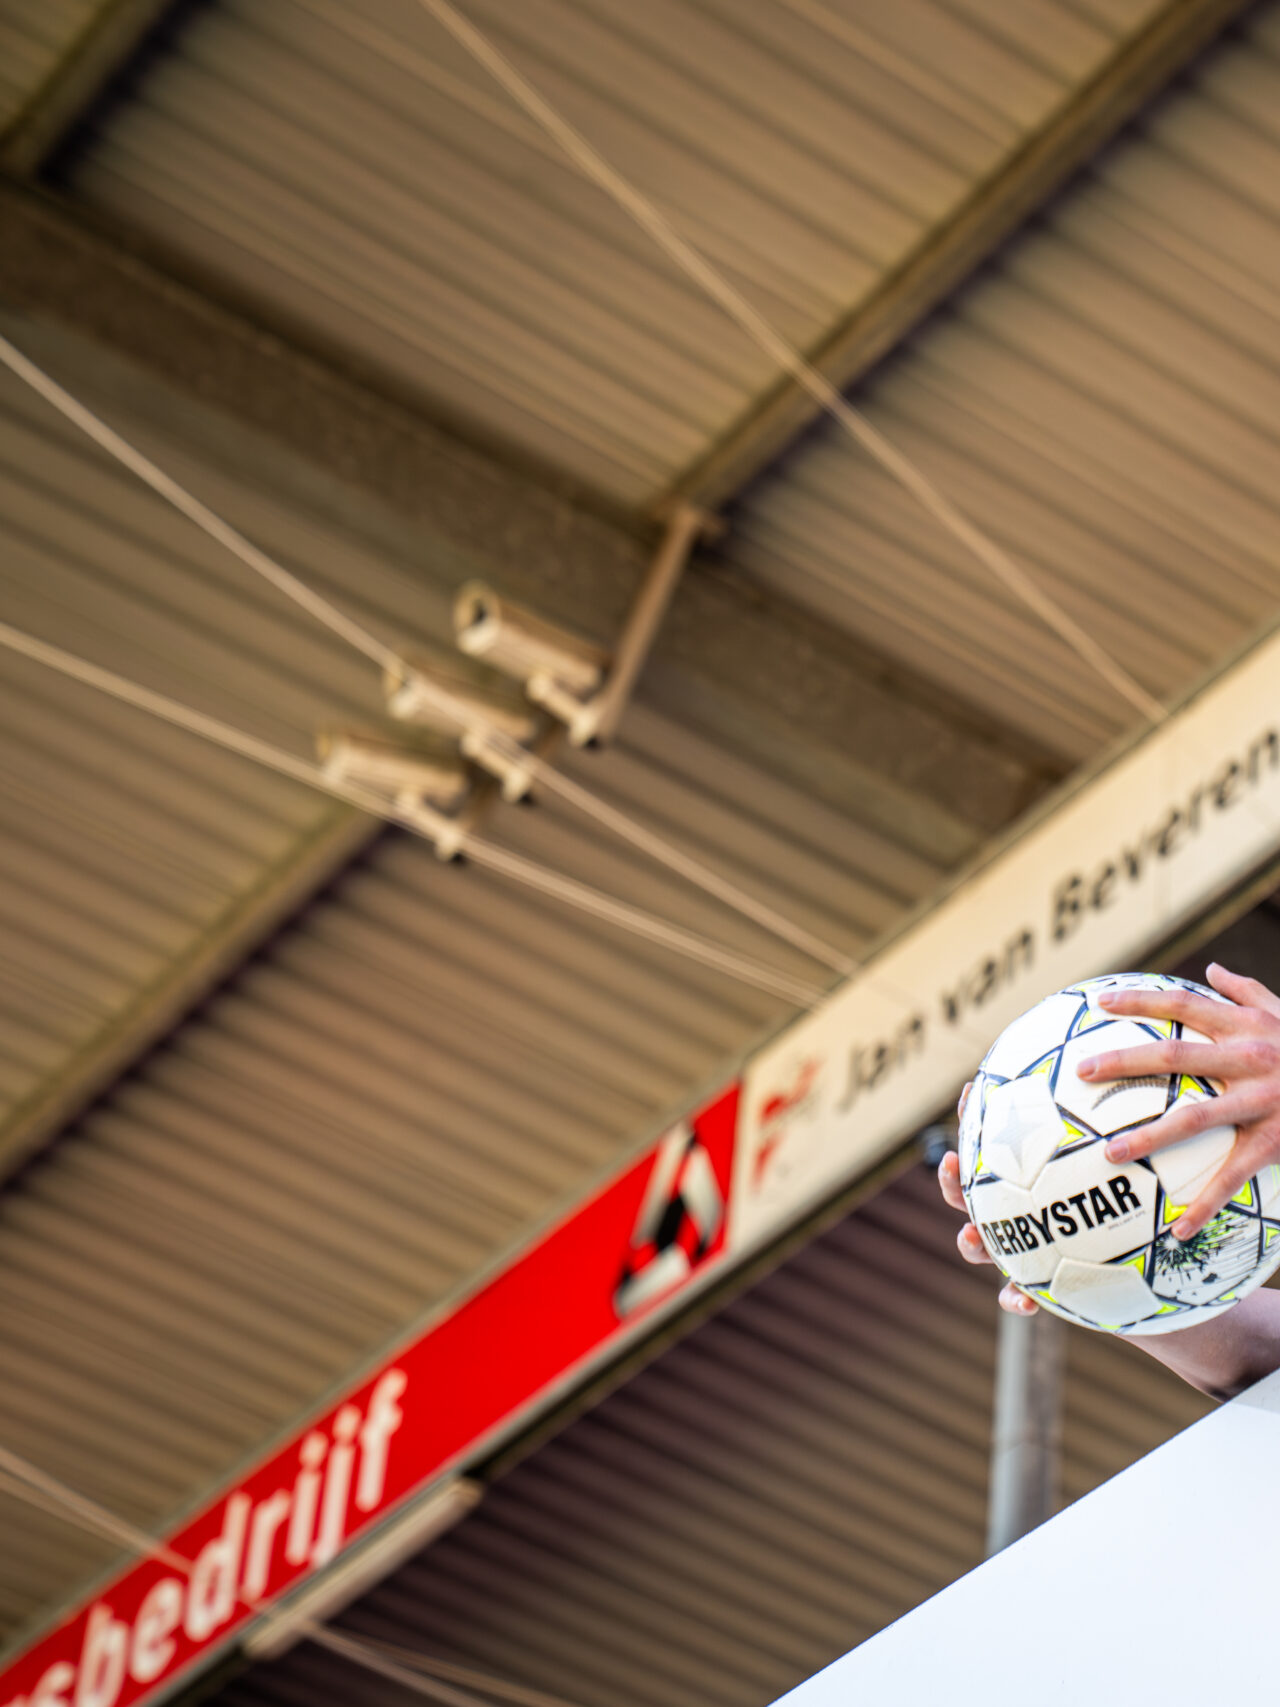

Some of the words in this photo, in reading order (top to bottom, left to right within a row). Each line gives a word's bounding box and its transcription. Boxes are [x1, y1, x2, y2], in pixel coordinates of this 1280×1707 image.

[838, 1014, 924, 1114] Jan
[942, 926, 1034, 1026] van
[1052, 726, 1280, 944] Beveren
[981, 1174, 1142, 1257] DERBYSTAR
